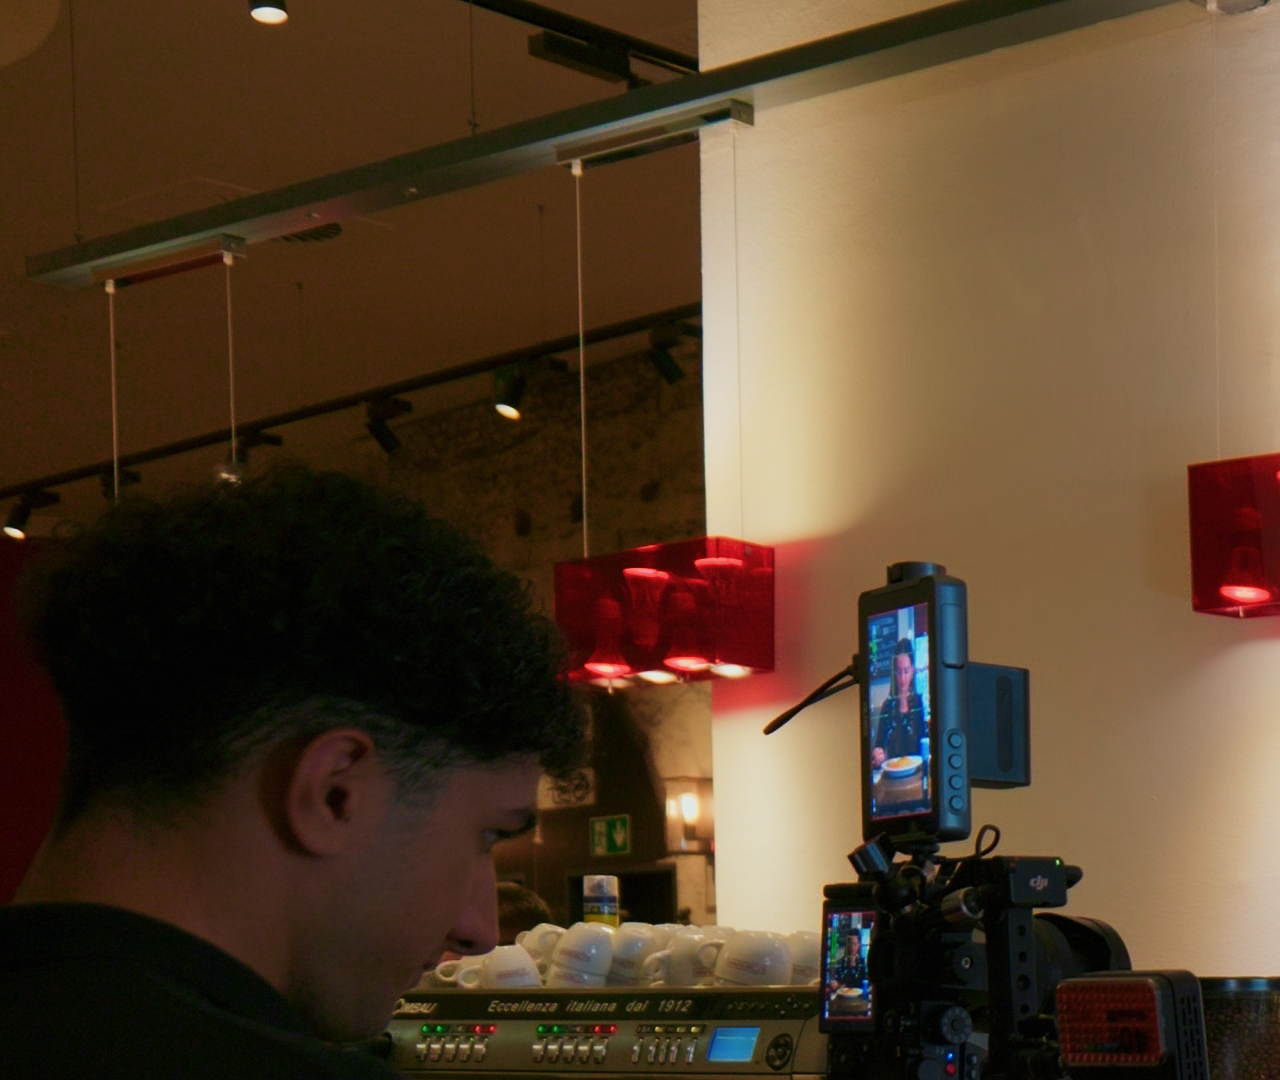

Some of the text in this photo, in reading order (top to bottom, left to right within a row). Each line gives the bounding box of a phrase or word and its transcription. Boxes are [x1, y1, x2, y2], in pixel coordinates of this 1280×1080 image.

[488, 999, 692, 1012] Eccellenza italiana dal 1912
